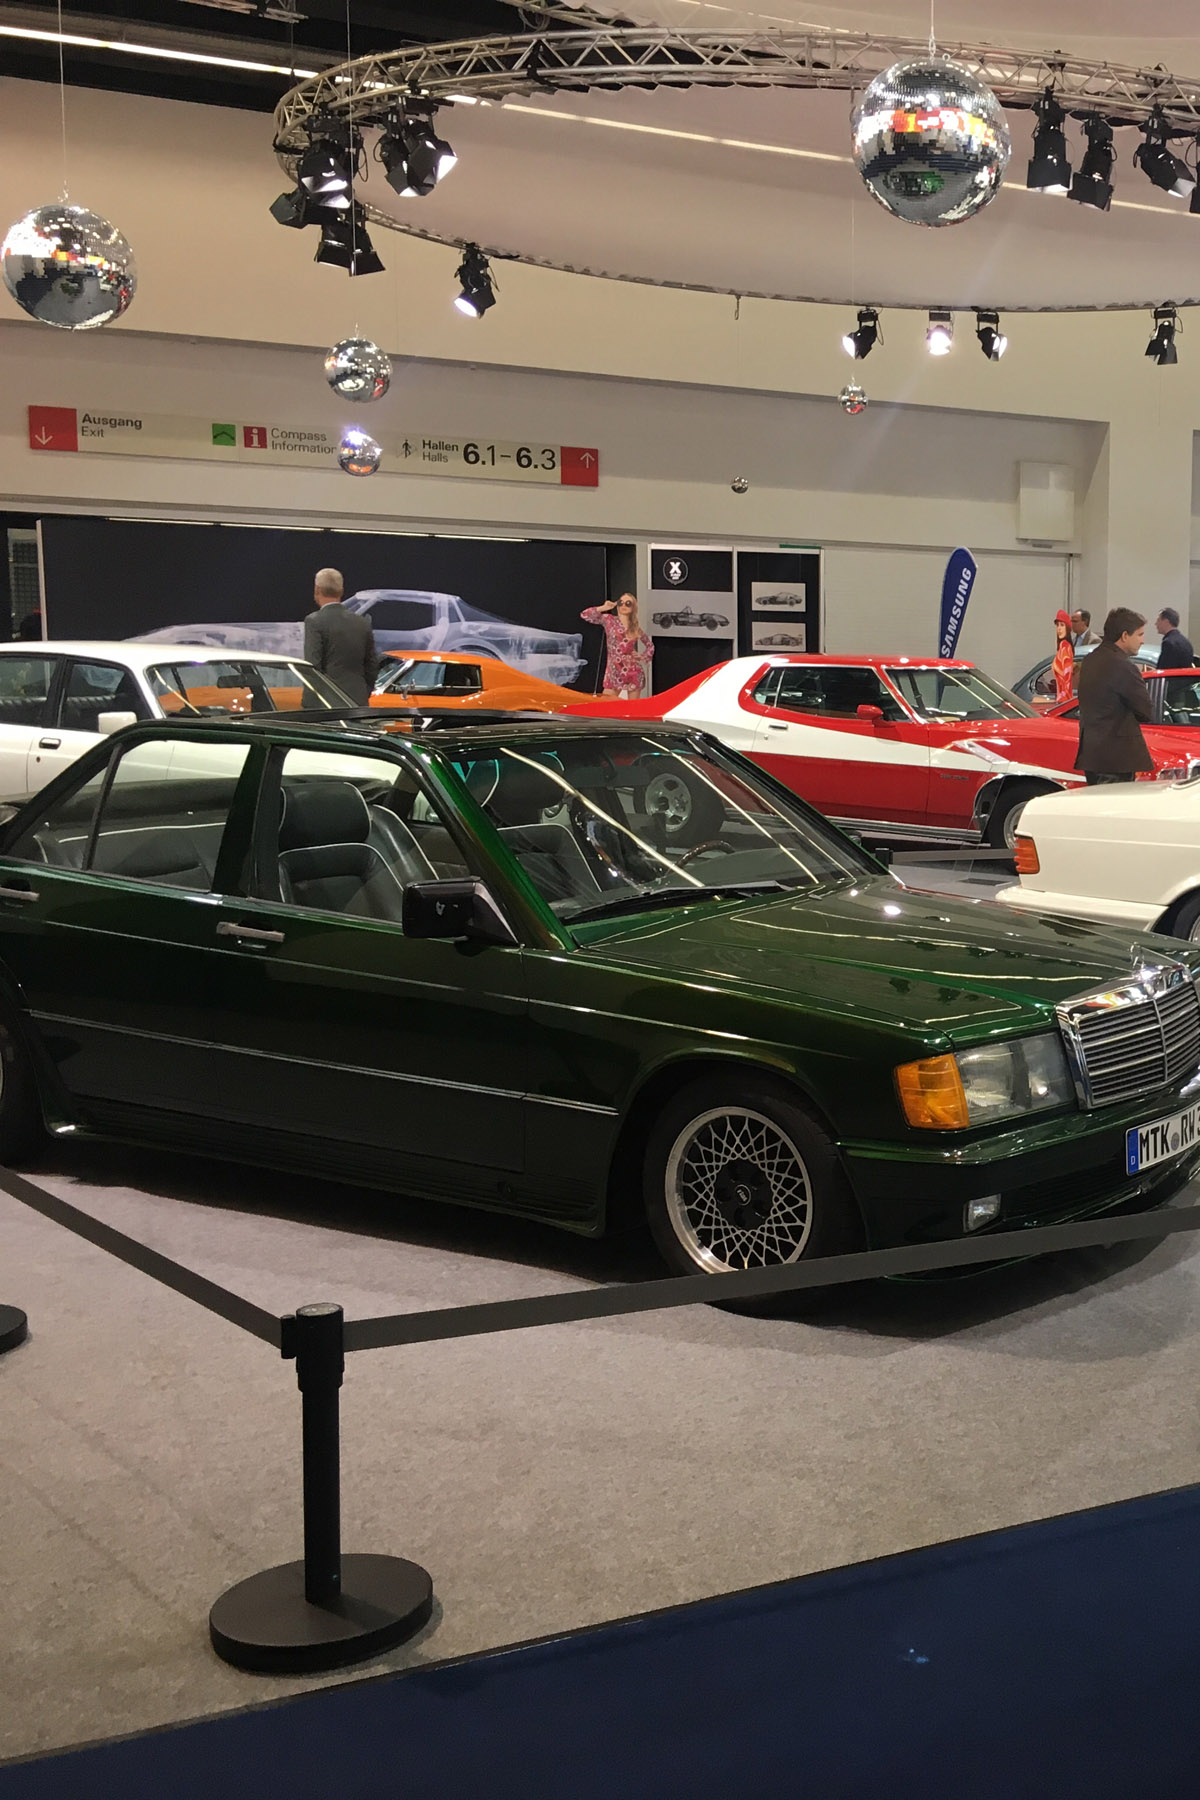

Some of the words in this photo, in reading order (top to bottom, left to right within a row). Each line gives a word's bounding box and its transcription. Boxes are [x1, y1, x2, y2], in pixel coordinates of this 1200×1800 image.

[81, 413, 143, 431] Ausgang
[81, 426, 105, 438] Exit
[271, 427, 327, 442] Compass
[422, 439, 459, 452] Hallen
[422, 451, 449, 463] Halls
[669, 561, 682, 574] X
[941, 567, 972, 658] SAMSUNG
[1139, 1121, 1170, 1164] MTK
[1131, 1156, 1135, 1165] D
